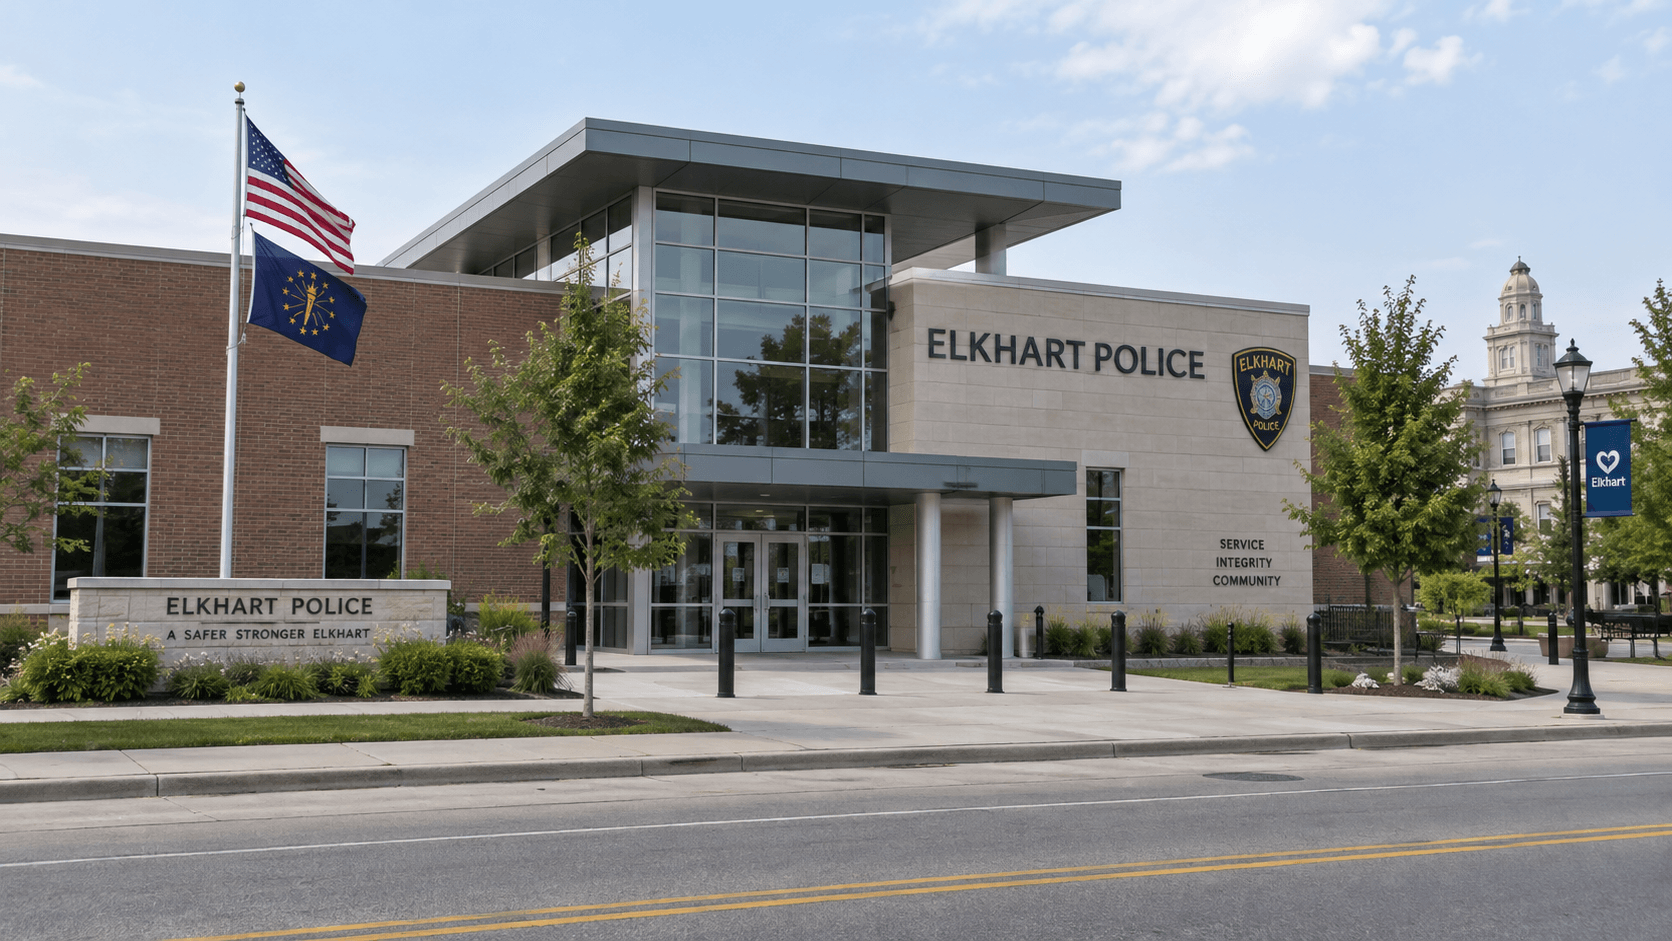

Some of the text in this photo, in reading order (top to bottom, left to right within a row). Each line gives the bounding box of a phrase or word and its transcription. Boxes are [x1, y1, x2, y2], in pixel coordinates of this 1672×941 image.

[927, 327, 1206, 380] ELKHART POLICE
[1239, 355, 1292, 376] ELKHART
[1253, 420, 1280, 431] POLICE
[1591, 476, 1626, 488] Elkhart
[1220, 538, 1265, 550] SERVICE
[1216, 556, 1272, 568] INTEGRITY
[1212, 574, 1281, 587] COMMUNITY
[166, 597, 373, 615] ELKHART POLICE
[166, 628, 371, 640] A SAFER STRONGER ELKHART
